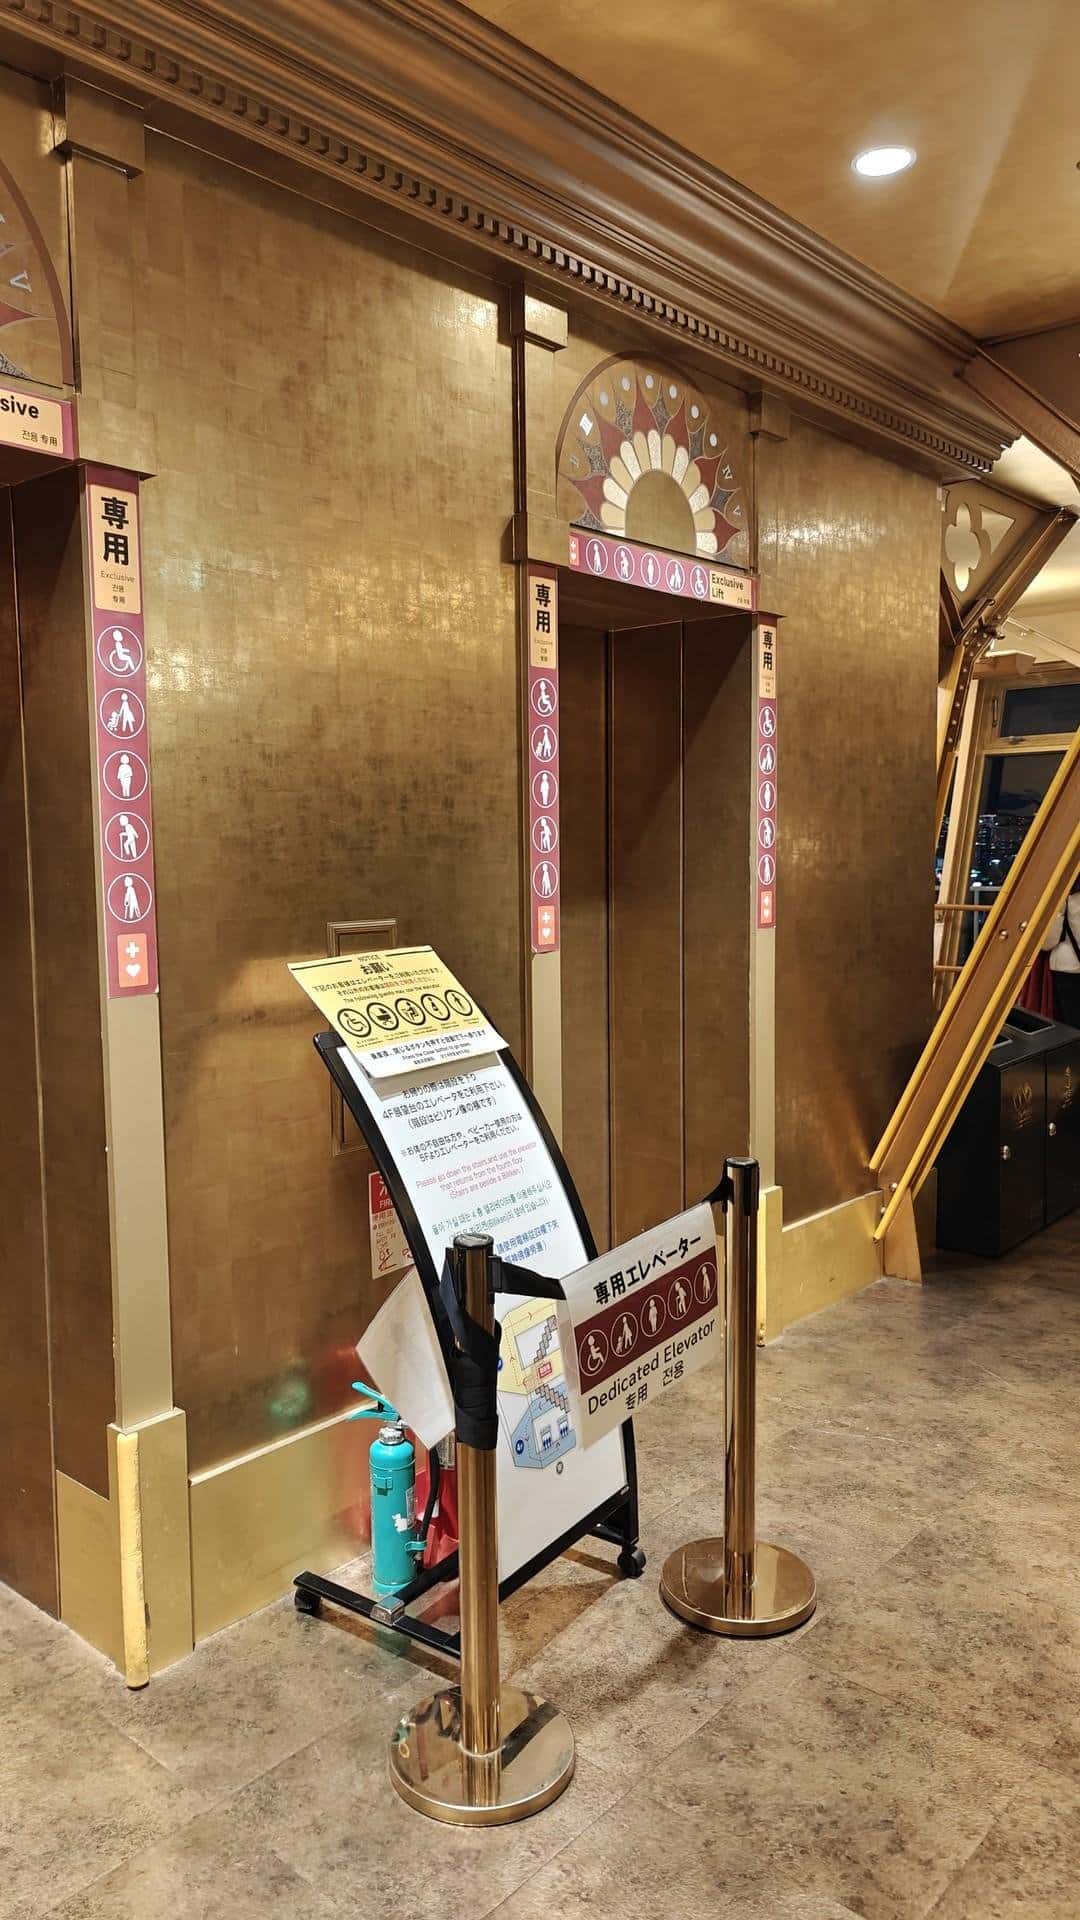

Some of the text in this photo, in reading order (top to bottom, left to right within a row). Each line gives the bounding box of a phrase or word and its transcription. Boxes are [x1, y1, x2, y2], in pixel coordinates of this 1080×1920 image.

[101, 496, 129, 566] 専用
[100, 570, 135, 583] Exclusive
[711, 587, 724, 600] Lift
[712, 573, 744, 590] Exclusive
[535, 584, 551, 633] 専用
[763, 630, 773, 671] 専用
[360, 961, 394, 974] お願い
[415, 1176, 437, 1189] Please
[446, 1169, 461, 1178] down
[593, 1236, 702, 1305] 専用エレベーター
[587, 1318, 716, 1416] Dedicated Elevator
[625, 1359, 684, 1410] 专用 전용
